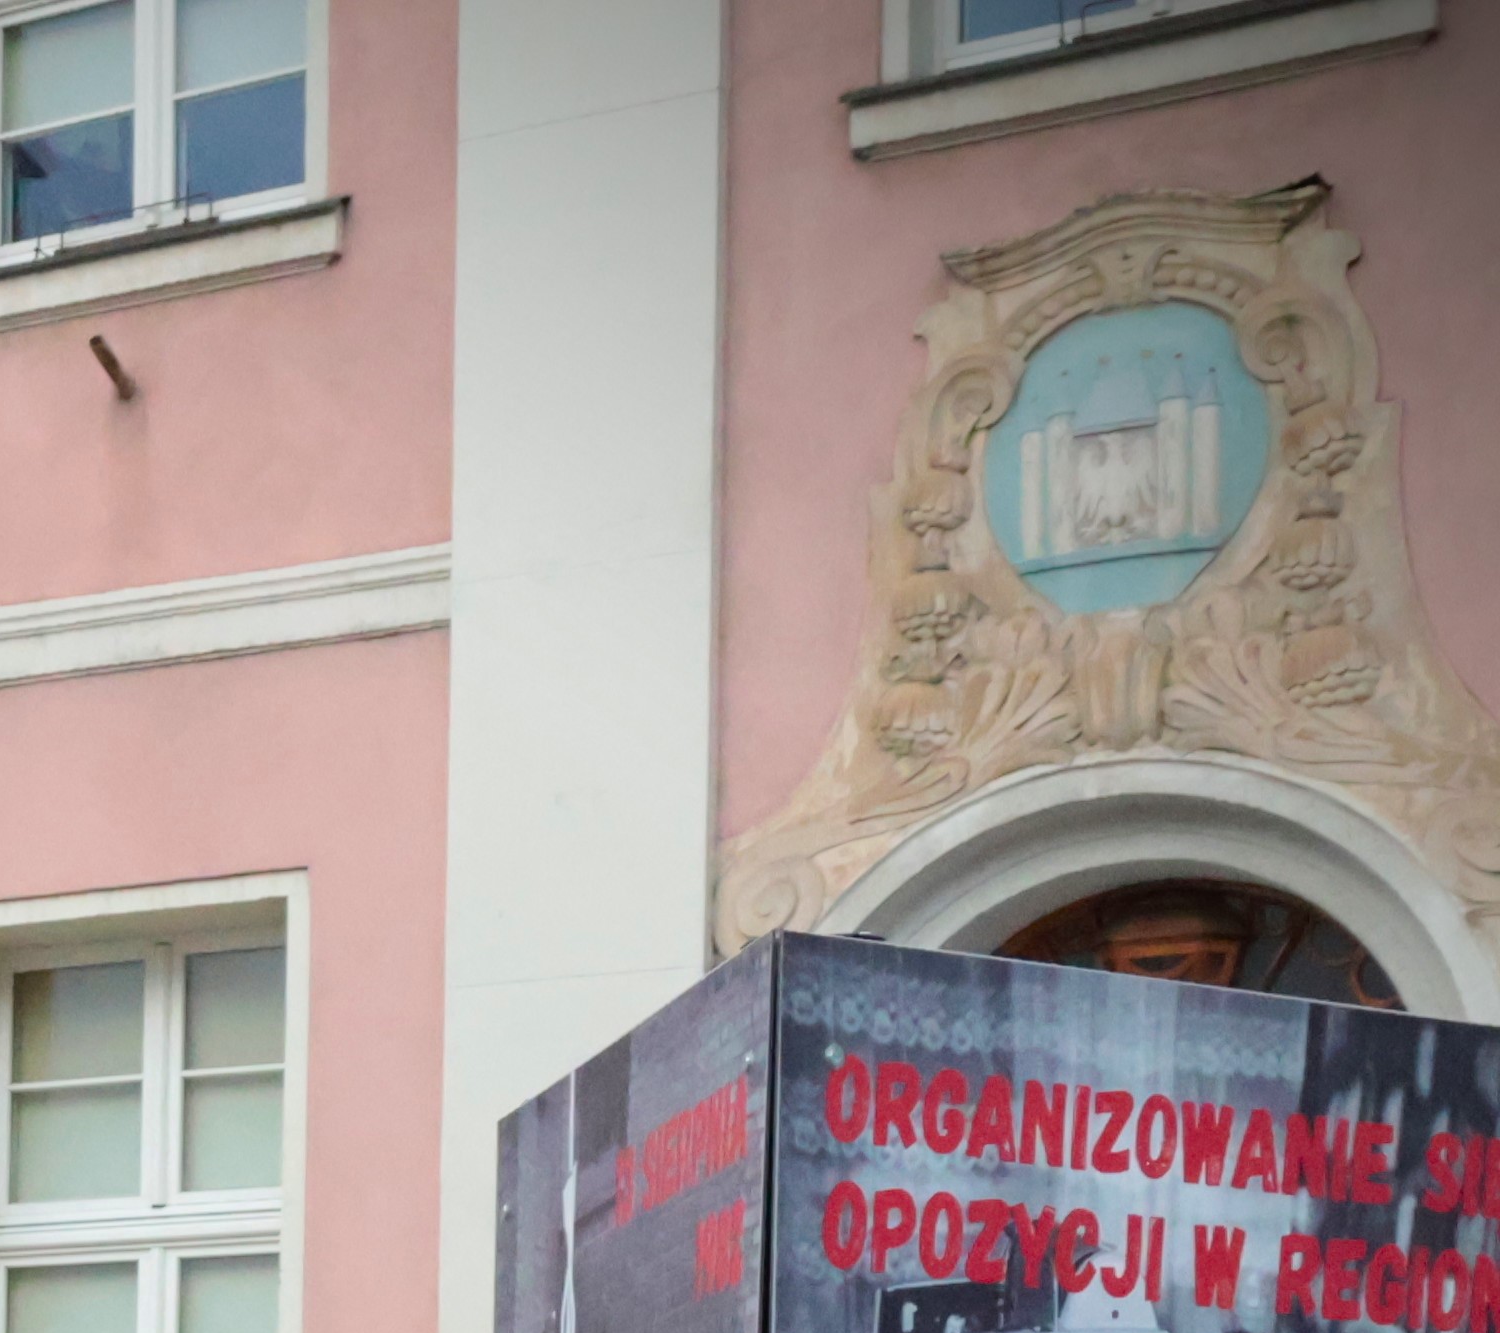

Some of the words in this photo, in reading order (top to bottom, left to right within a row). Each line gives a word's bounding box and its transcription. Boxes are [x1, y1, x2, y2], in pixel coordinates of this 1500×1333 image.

[825, 1054, 1394, 1204] ORGANIZOWANIE
[822, 1181, 1164, 1302] OPOZYCJI
[1195, 1225, 1245, 1310] W
